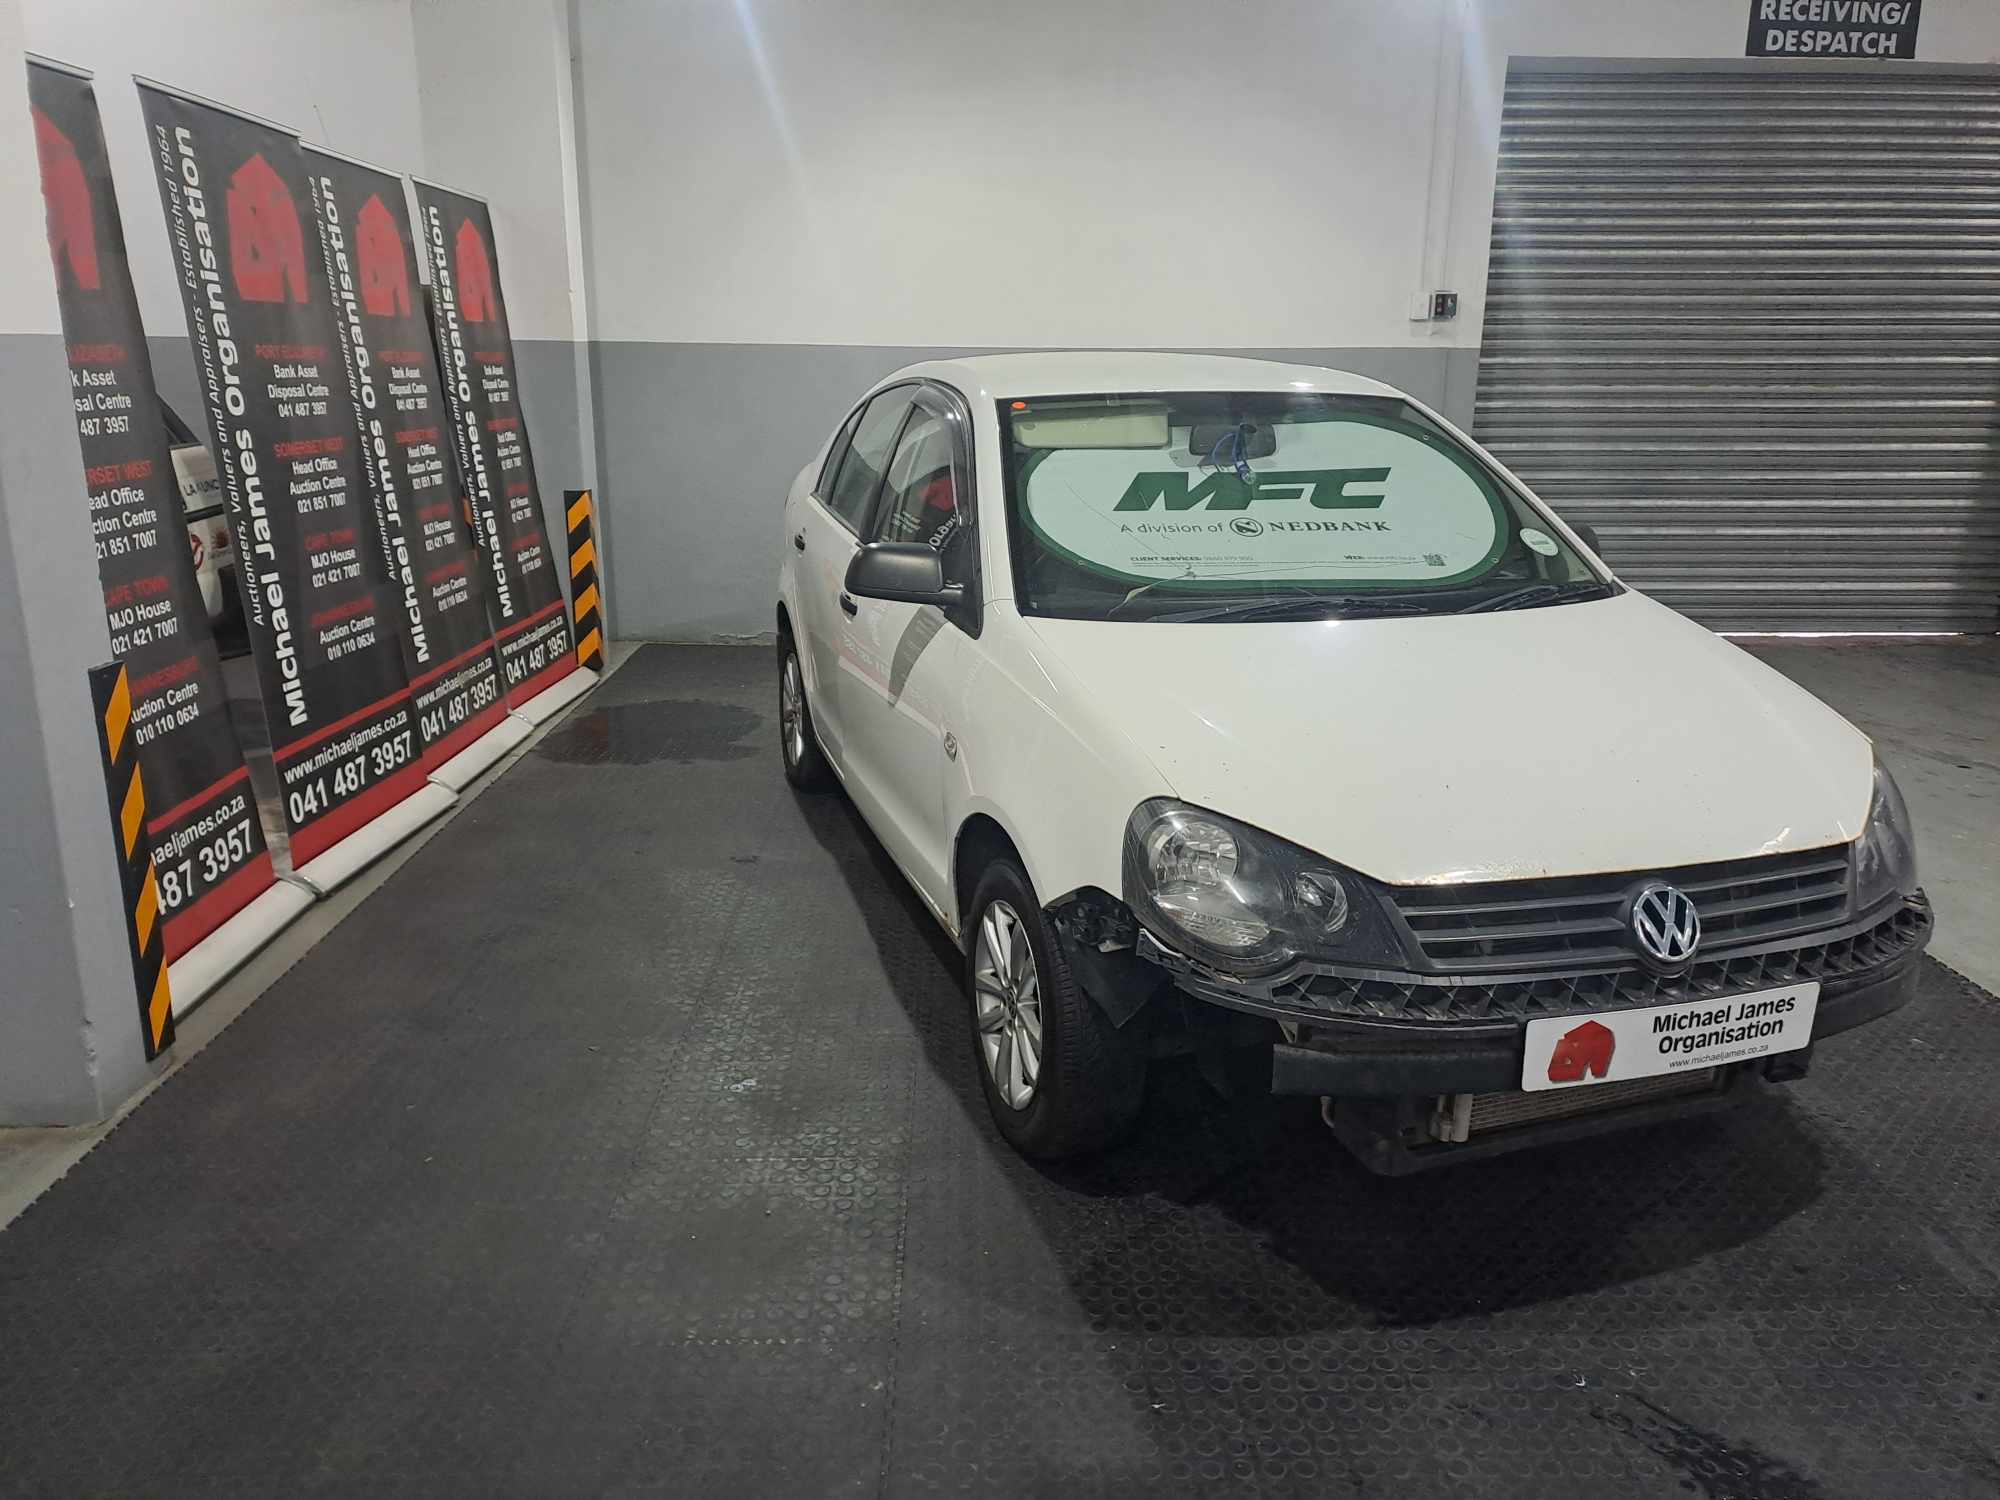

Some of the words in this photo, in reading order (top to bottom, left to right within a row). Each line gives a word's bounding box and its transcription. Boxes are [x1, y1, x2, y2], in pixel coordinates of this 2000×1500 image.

[1760, 0, 1911, 25] RECEIVING/
[1765, 29, 1897, 54] DESPATCH
[155, 124, 173, 174] 1964
[164, 177, 198, 289] Established
[175, 126, 245, 417] Organisation
[320, 175, 375, 409] Organisation
[428, 205, 472, 402] Organisation
[193, 306, 220, 405] Appraisers
[273, 364, 296, 379] Bank
[83, 369, 116, 386] Asset
[267, 384, 305, 401] Disposal
[96, 393, 131, 410] Centre
[278, 402, 293, 418] 041
[354, 402, 366, 430] and
[81, 417, 100, 436] 487
[104, 415, 129, 434] 3957
[211, 407, 228, 443] and
[292, 461, 314, 475] Head
[314, 457, 338, 472] Office
[359, 433, 377, 488] Valuers
[370, 418, 401, 527] James
[465, 410, 491, 502] James
[110, 486, 145, 506] Office
[222, 447, 242, 513] Valuers
[236, 428, 275, 561] James
[289, 479, 322, 495] Auction
[1112, 467, 1392, 511] MFC
[122, 509, 157, 528] Centre
[297, 499, 313, 513] 021
[313, 495, 329, 511] 851
[109, 535, 130, 555] 851
[132, 529, 157, 550] 7007
[1120, 523, 1133, 534] A
[1137, 521, 1202, 534] division
[1207, 521, 1225, 533] of
[1268, 520, 1392, 533] NEDBANK
[237, 519, 264, 626] Auctioneers,
[310, 551, 330, 569] MJO
[330, 548, 356, 564] House
[482, 509, 513, 617] Michael
[312, 572, 327, 588] 021
[327, 568, 343, 584] 421
[109, 608, 134, 632] MJO
[136, 599, 172, 623] House
[391, 536, 430, 663] Michael
[112, 635, 131, 655] 021
[133, 625, 153, 647] 421
[155, 617, 178, 640] 7007
[260, 571, 308, 727] Michael
[319, 624, 350, 645] Auction
[350, 615, 375, 633] Centre
[327, 645, 342, 661] 010
[342, 638, 357, 655] 110
[357, 631, 376, 648] 0634
[506, 655, 528, 684] 041
[529, 644, 546, 671] 487
[547, 630, 568, 659] 3957
[131, 696, 165, 723] uction
[166, 682, 199, 706] Centre
[420, 706, 447, 742] 041
[449, 690, 470, 724] 487
[471, 673, 497, 709] 3957
[136, 724, 155, 746] 010
[155, 714, 175, 736] 110
[177, 702, 200, 725] 0634
[284, 710, 407, 784] www.michaeljames.co.za
[289, 777, 328, 824] 041
[334, 754, 366, 796] 487
[371, 730, 412, 776] 3957
[199, 817, 251, 882] 3957
[1652, 1004, 1731, 1034] Michael
[1735, 995, 1796, 1023] James
[1658, 1017, 1784, 1054] Organisation
[1668, 1043, 1769, 1069] www.michaeljames.co.za
